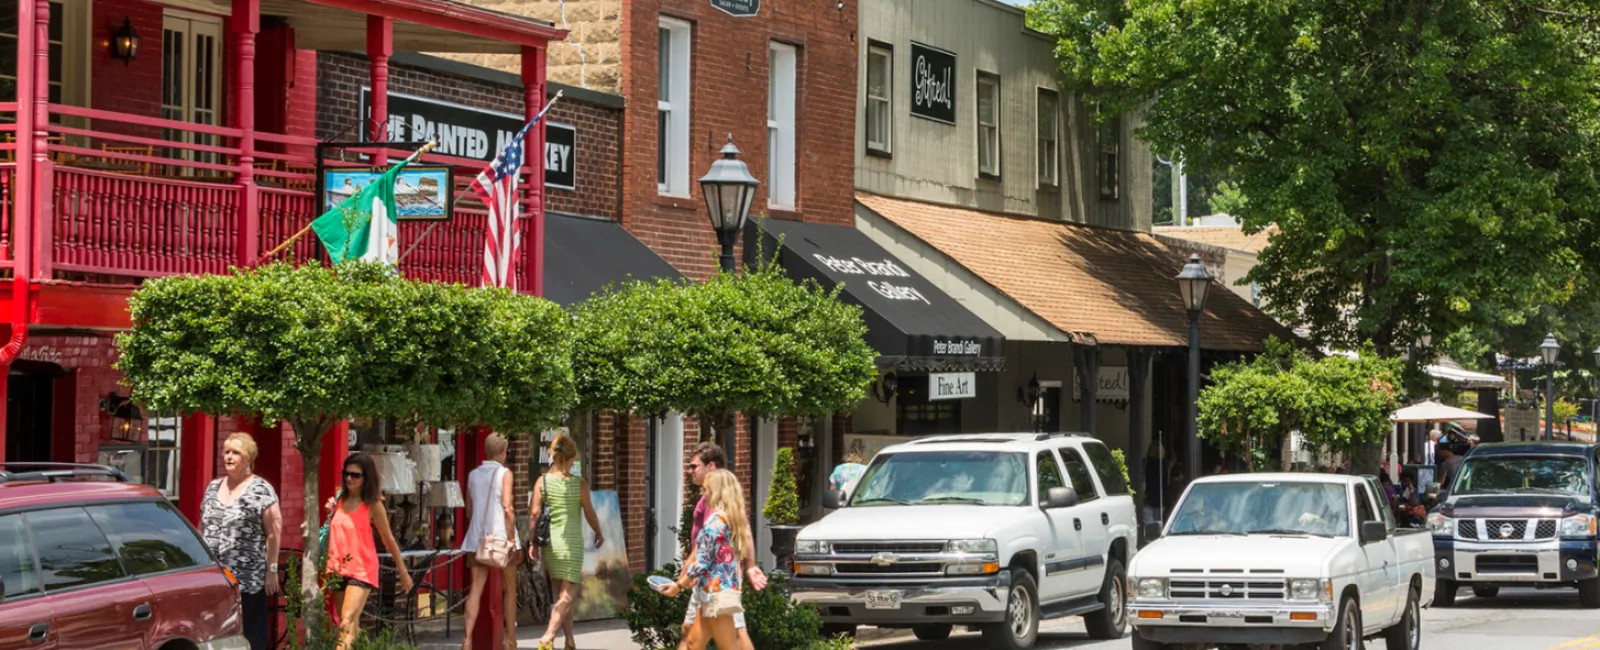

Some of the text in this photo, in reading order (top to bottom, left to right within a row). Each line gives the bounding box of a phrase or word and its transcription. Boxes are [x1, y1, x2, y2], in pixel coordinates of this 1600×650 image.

[915, 55, 951, 109] Gifted!
[368, 106, 570, 172] HE PAINTED MKEY
[812, 253, 911, 278] Peter Brandi
[867, 280, 931, 305] Gallery
[933, 340, 981, 357] Peter Brandi Gallery
[937, 376, 969, 396] Fine Art
